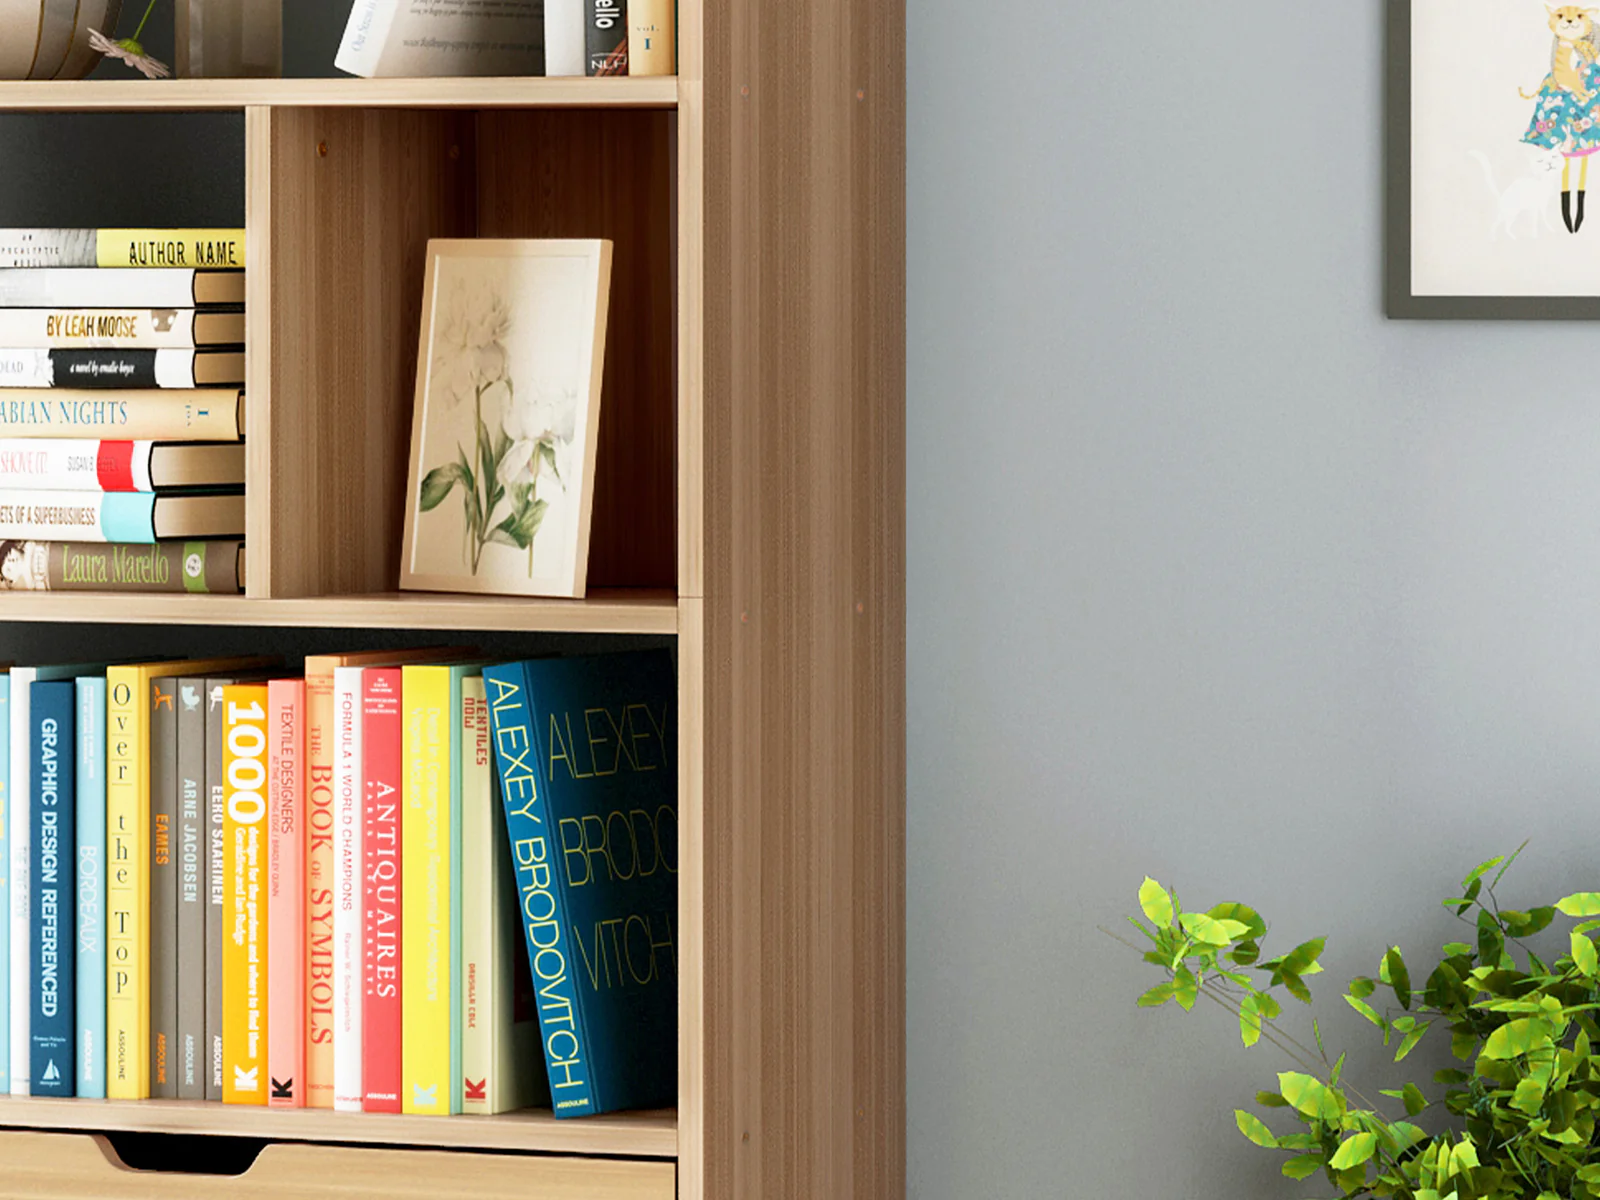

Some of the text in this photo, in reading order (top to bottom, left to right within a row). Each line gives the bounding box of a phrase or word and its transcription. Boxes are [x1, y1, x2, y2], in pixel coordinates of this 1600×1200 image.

[196, 241, 239, 266] NAME
[46, 315, 138, 338] BY LEAH MOOSE
[60, 400, 128, 425] NIGHTS
[16, 506, 25, 525] OF
[27, 506, 32, 524] A
[34, 506, 96, 526] SUPERBUSINESS
[63, 545, 108, 583] Laura
[112, 546, 170, 584] Marello
[342, 692, 352, 759] FORMULA
[476, 698, 487, 766] TEXTILES
[549, 702, 667, 782] ALEXEY
[41, 718, 58, 806] GRAPHIC
[227, 700, 266, 824] 1000
[272, 756, 280, 766] AT
[272, 767, 280, 781] THE
[281, 704, 294, 834] TEXTILE DESIGNERS
[272, 783, 280, 812] CUTTING
[272, 814, 280, 832] EDGE
[342, 774, 352, 825] WORLD
[41, 812, 58, 882] DESIGN
[114, 683, 131, 994] Over the Top
[156, 814, 169, 865] EAMES
[184, 779, 196, 902] ARNE JACOBSEN
[212, 786, 223, 904] EERO SAARINEN
[235, 827, 246, 874] Geraldine
[246, 826, 259, 866] designs
[272, 840, 280, 871] BRADLEY
[248, 868, 258, 882] for
[310, 725, 332, 1045] THE BOOK OF SYMBOLS
[342, 829, 352, 911] CHAMPIONS
[372, 780, 396, 998] ANTIQUAIRES
[488, 678, 584, 1089] ALEXEY BRODOVITCH
[79, 846, 98, 954] BORDEAUX
[41, 889, 58, 1017] REFERENCED
[248, 944, 258, 962] and
[344, 932, 352, 959] Rainer
[573, 913, 677, 992] VITCH
[248, 964, 258, 995] where
[249, 997, 258, 1008] to
[248, 1010, 258, 1030] find
[248, 1032, 258, 1058] them
[84, 1028, 92, 1082] ASSOULINE
[157, 1032, 166, 1084] ASSOULINE
[185, 1034, 194, 1086] ASSOULINE
[213, 1035, 222, 1086] ASSOULINE
